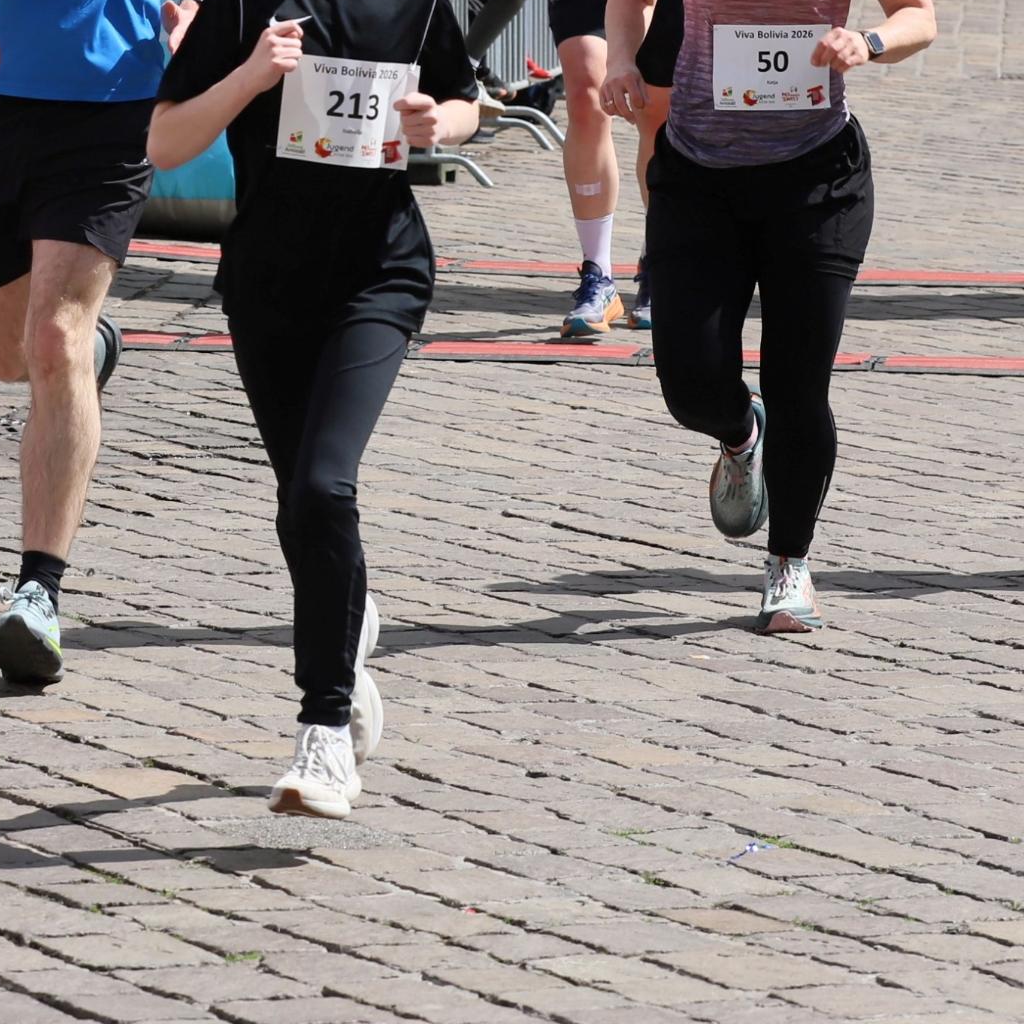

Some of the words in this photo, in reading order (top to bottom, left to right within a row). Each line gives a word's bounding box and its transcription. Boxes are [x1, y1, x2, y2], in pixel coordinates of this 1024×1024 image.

[734, 30, 755, 39] Viva
[757, 30, 789, 39] Bolivia
[791, 30, 814, 39] 2026
[313, 62, 338, 75] Viva
[341, 65, 377, 79] Bolivia
[378, 68, 399, 80] 2026
[757, 50, 789, 73] 50
[326, 89, 380, 121] 213
